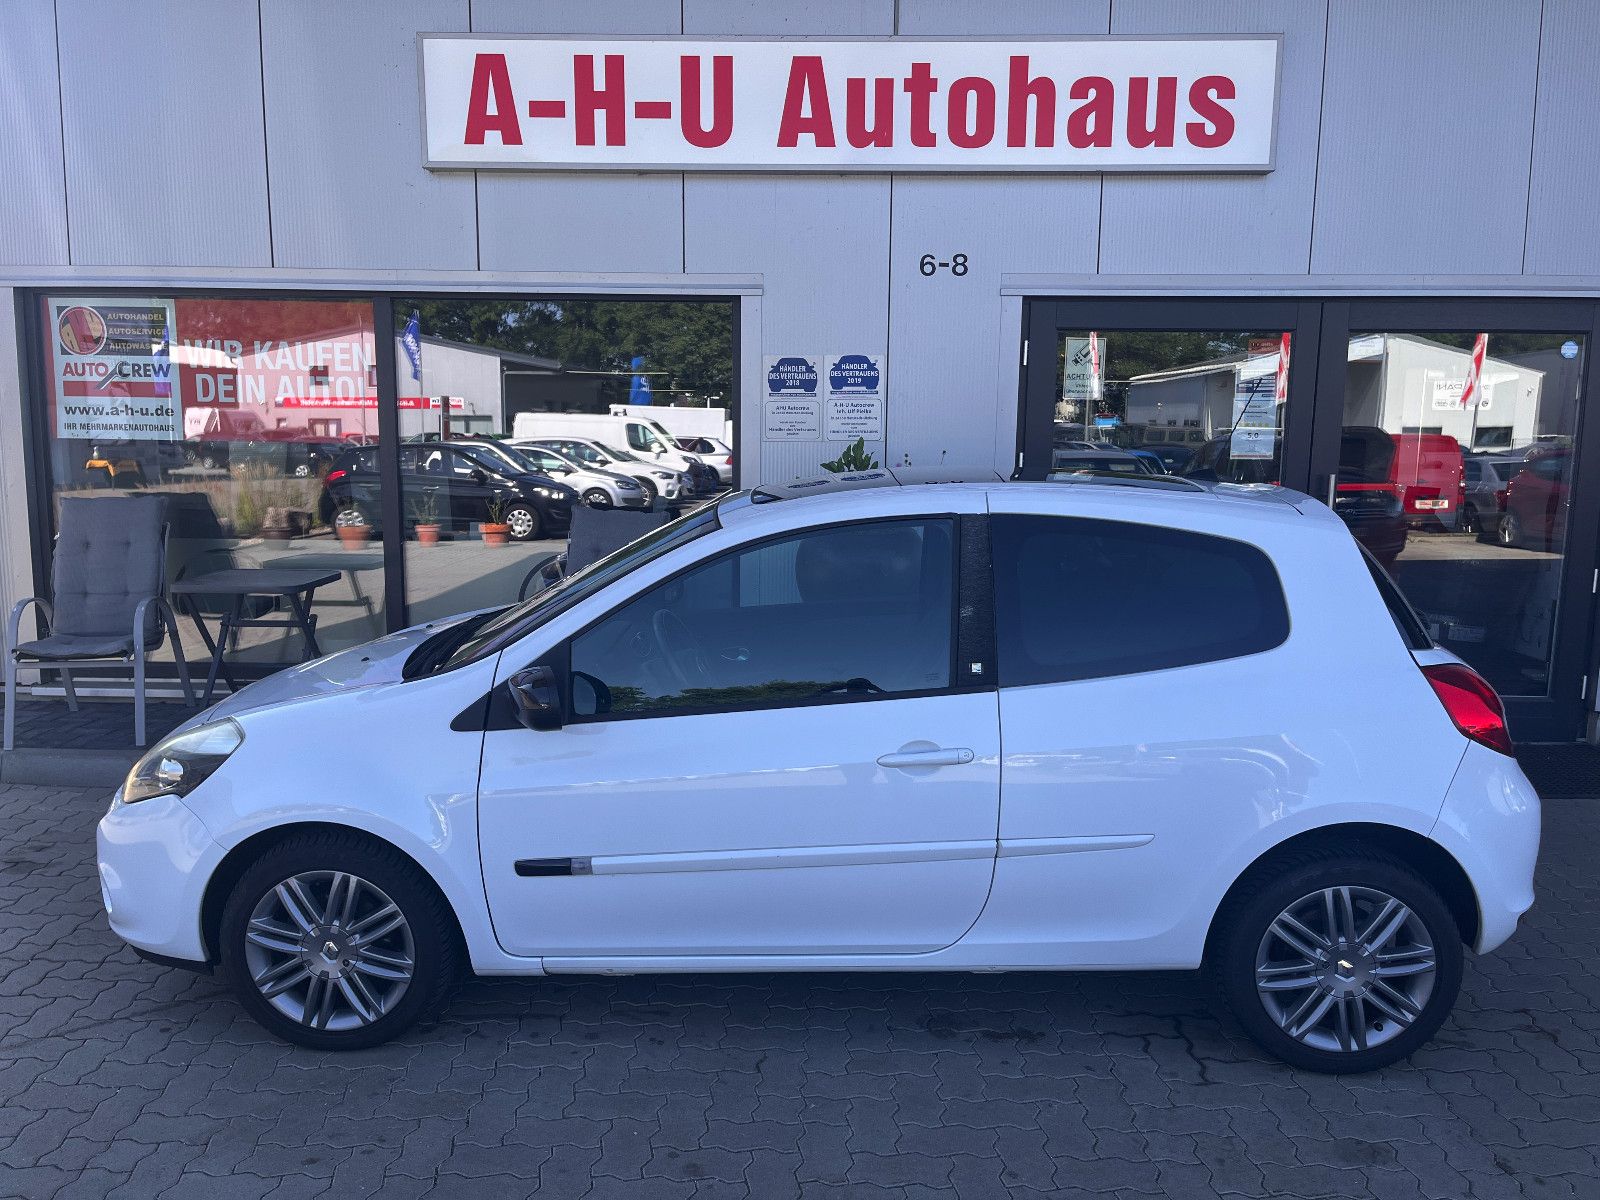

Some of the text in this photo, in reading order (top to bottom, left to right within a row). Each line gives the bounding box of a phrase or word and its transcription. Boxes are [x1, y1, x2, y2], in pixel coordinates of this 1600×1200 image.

[463, 53, 1236, 148] A-H-U Autohaus
[919, 253, 969, 277] 6-8
[107, 313, 164, 321] AUTOHANDEL
[108, 327, 167, 335] AUTOSERVICE
[110, 342, 168, 350] AUTOWASE
[183, 339, 244, 369] WIR
[253, 340, 372, 372] KAUFEN
[62, 361, 171, 378] AUTO CREW
[779, 364, 806, 372] HÄNDLER
[841, 362, 868, 370] HÄNDLER
[768, 372, 817, 380] DES VERTRAUENS
[785, 379, 800, 387] 2018
[195, 373, 265, 404] DEIN
[64, 404, 175, 417] www.a-h-u.de
[64, 422, 175, 432] IHR MEHRMARKENAUTOHAUS
